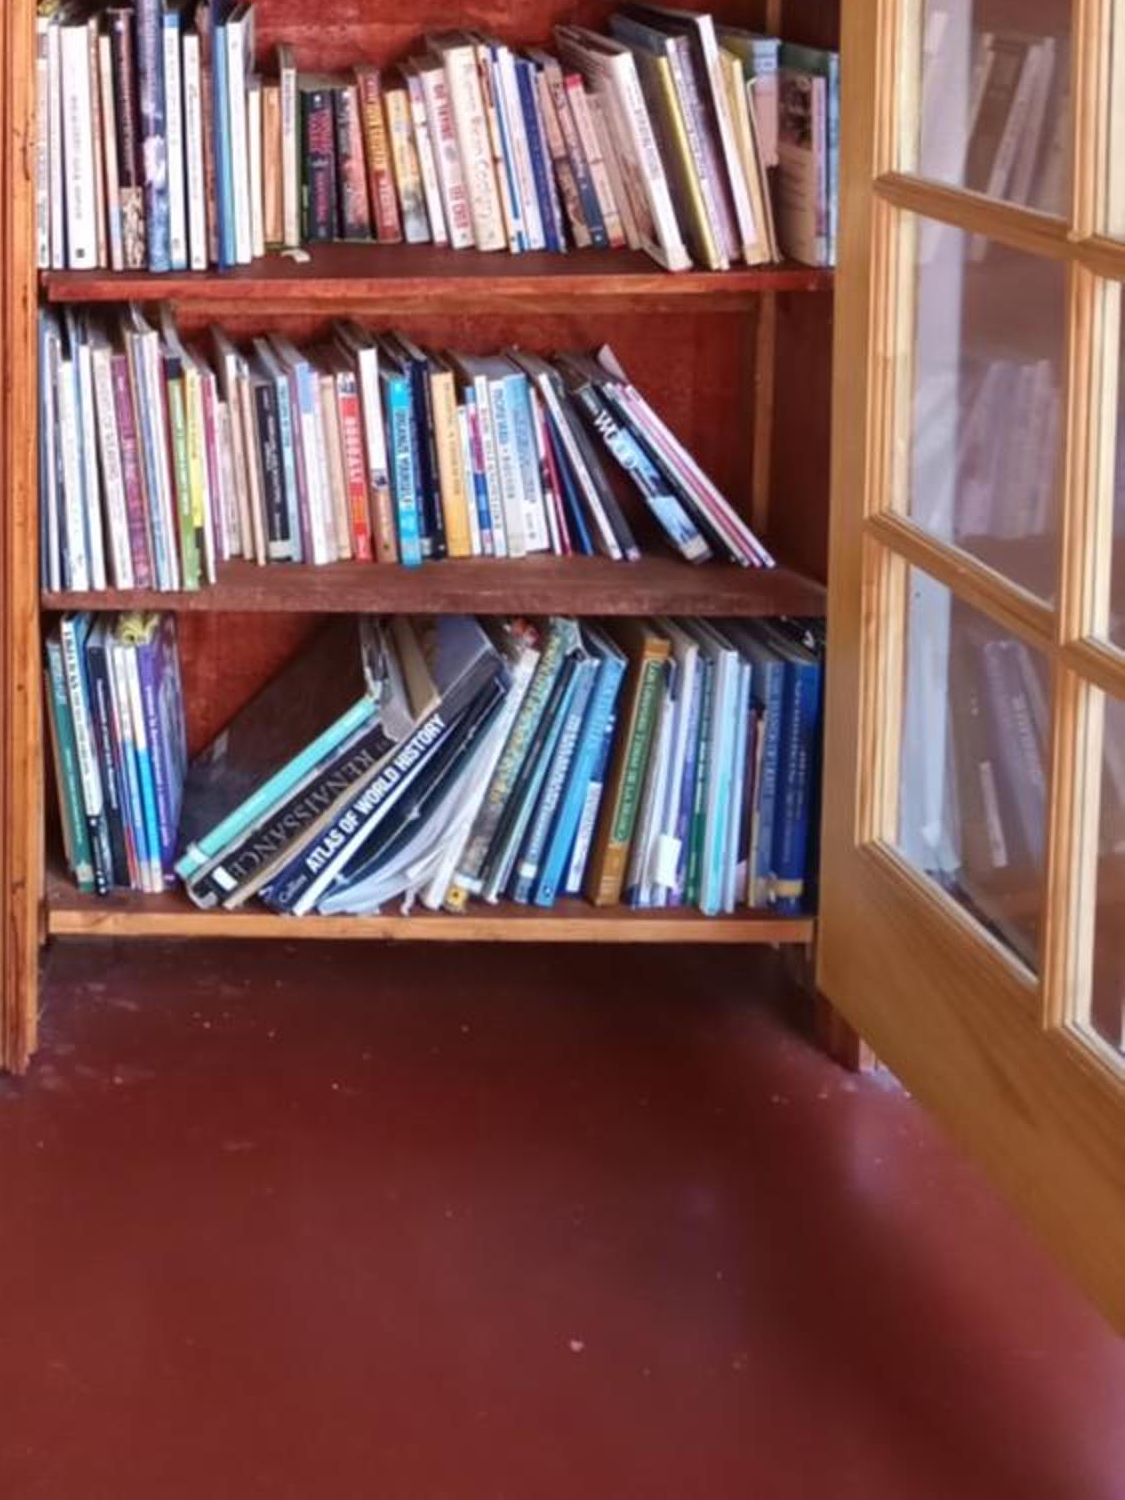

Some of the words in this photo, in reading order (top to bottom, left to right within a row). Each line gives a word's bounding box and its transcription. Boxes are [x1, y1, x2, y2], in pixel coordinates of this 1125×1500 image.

[227, 749, 375, 877] RENAISSANCE
[305, 828, 347, 874] ATLAS
[339, 811, 361, 834] OF
[355, 766, 401, 816] WORLD
[393, 713, 447, 772] HISTORY
